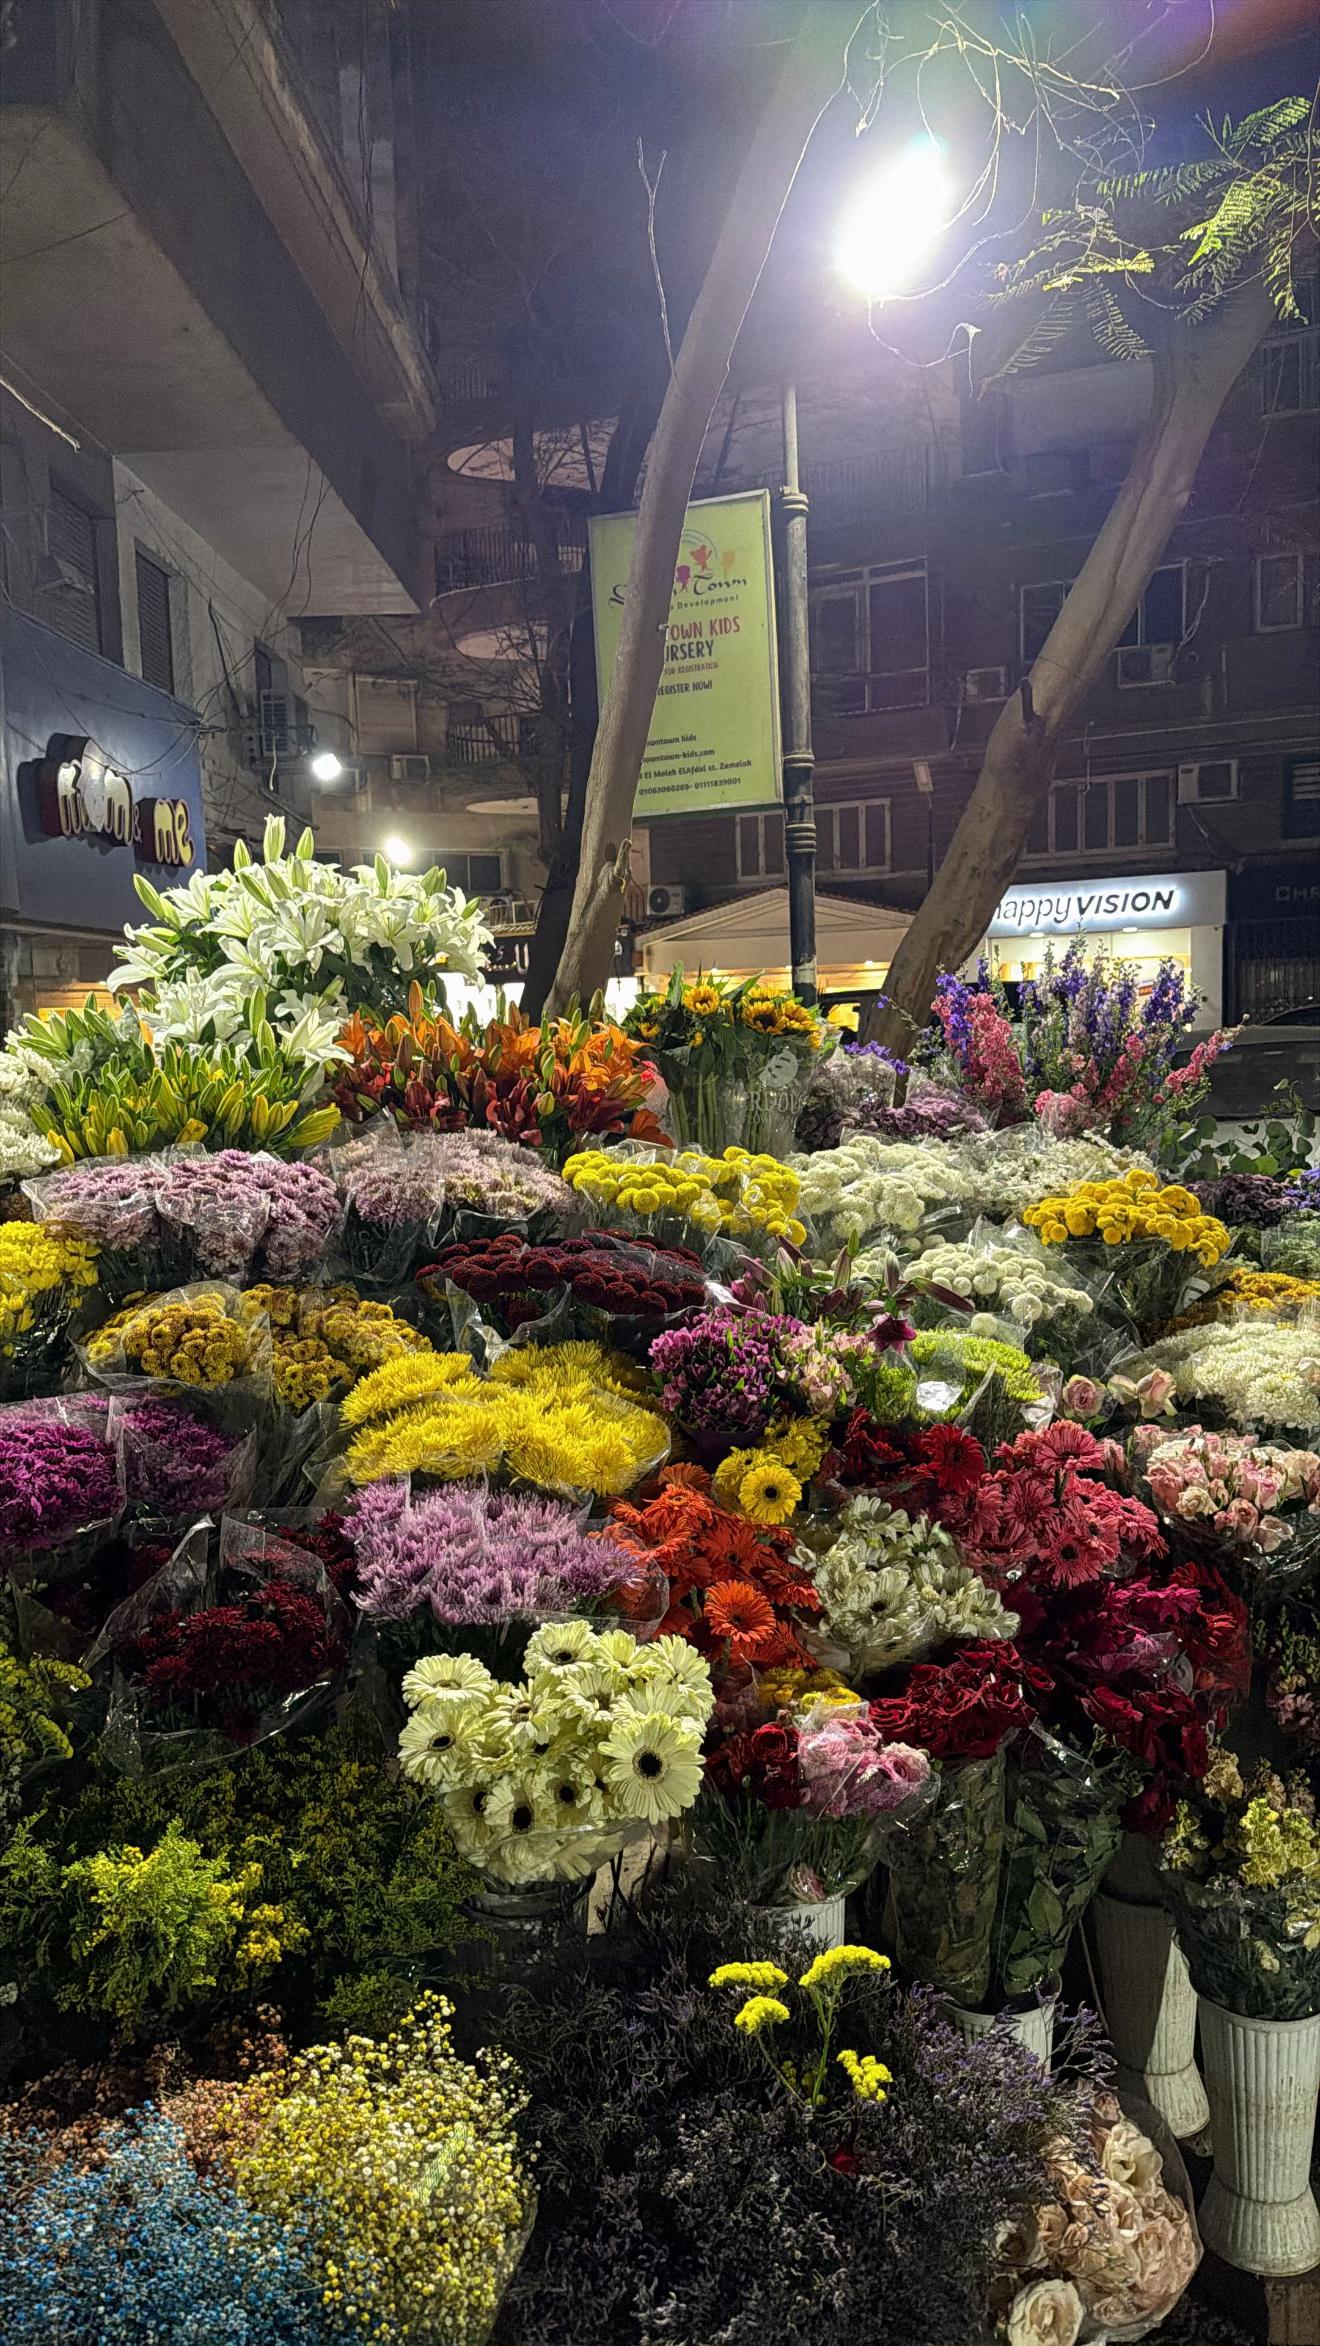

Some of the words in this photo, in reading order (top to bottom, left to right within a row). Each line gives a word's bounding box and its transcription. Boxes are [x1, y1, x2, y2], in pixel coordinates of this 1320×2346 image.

[677, 594, 739, 610] Development
[669, 621, 703, 641] OWN
[709, 616, 741, 636] KIDS
[153, 798, 195, 867] me
[1076, 889, 1175, 916] VISION
